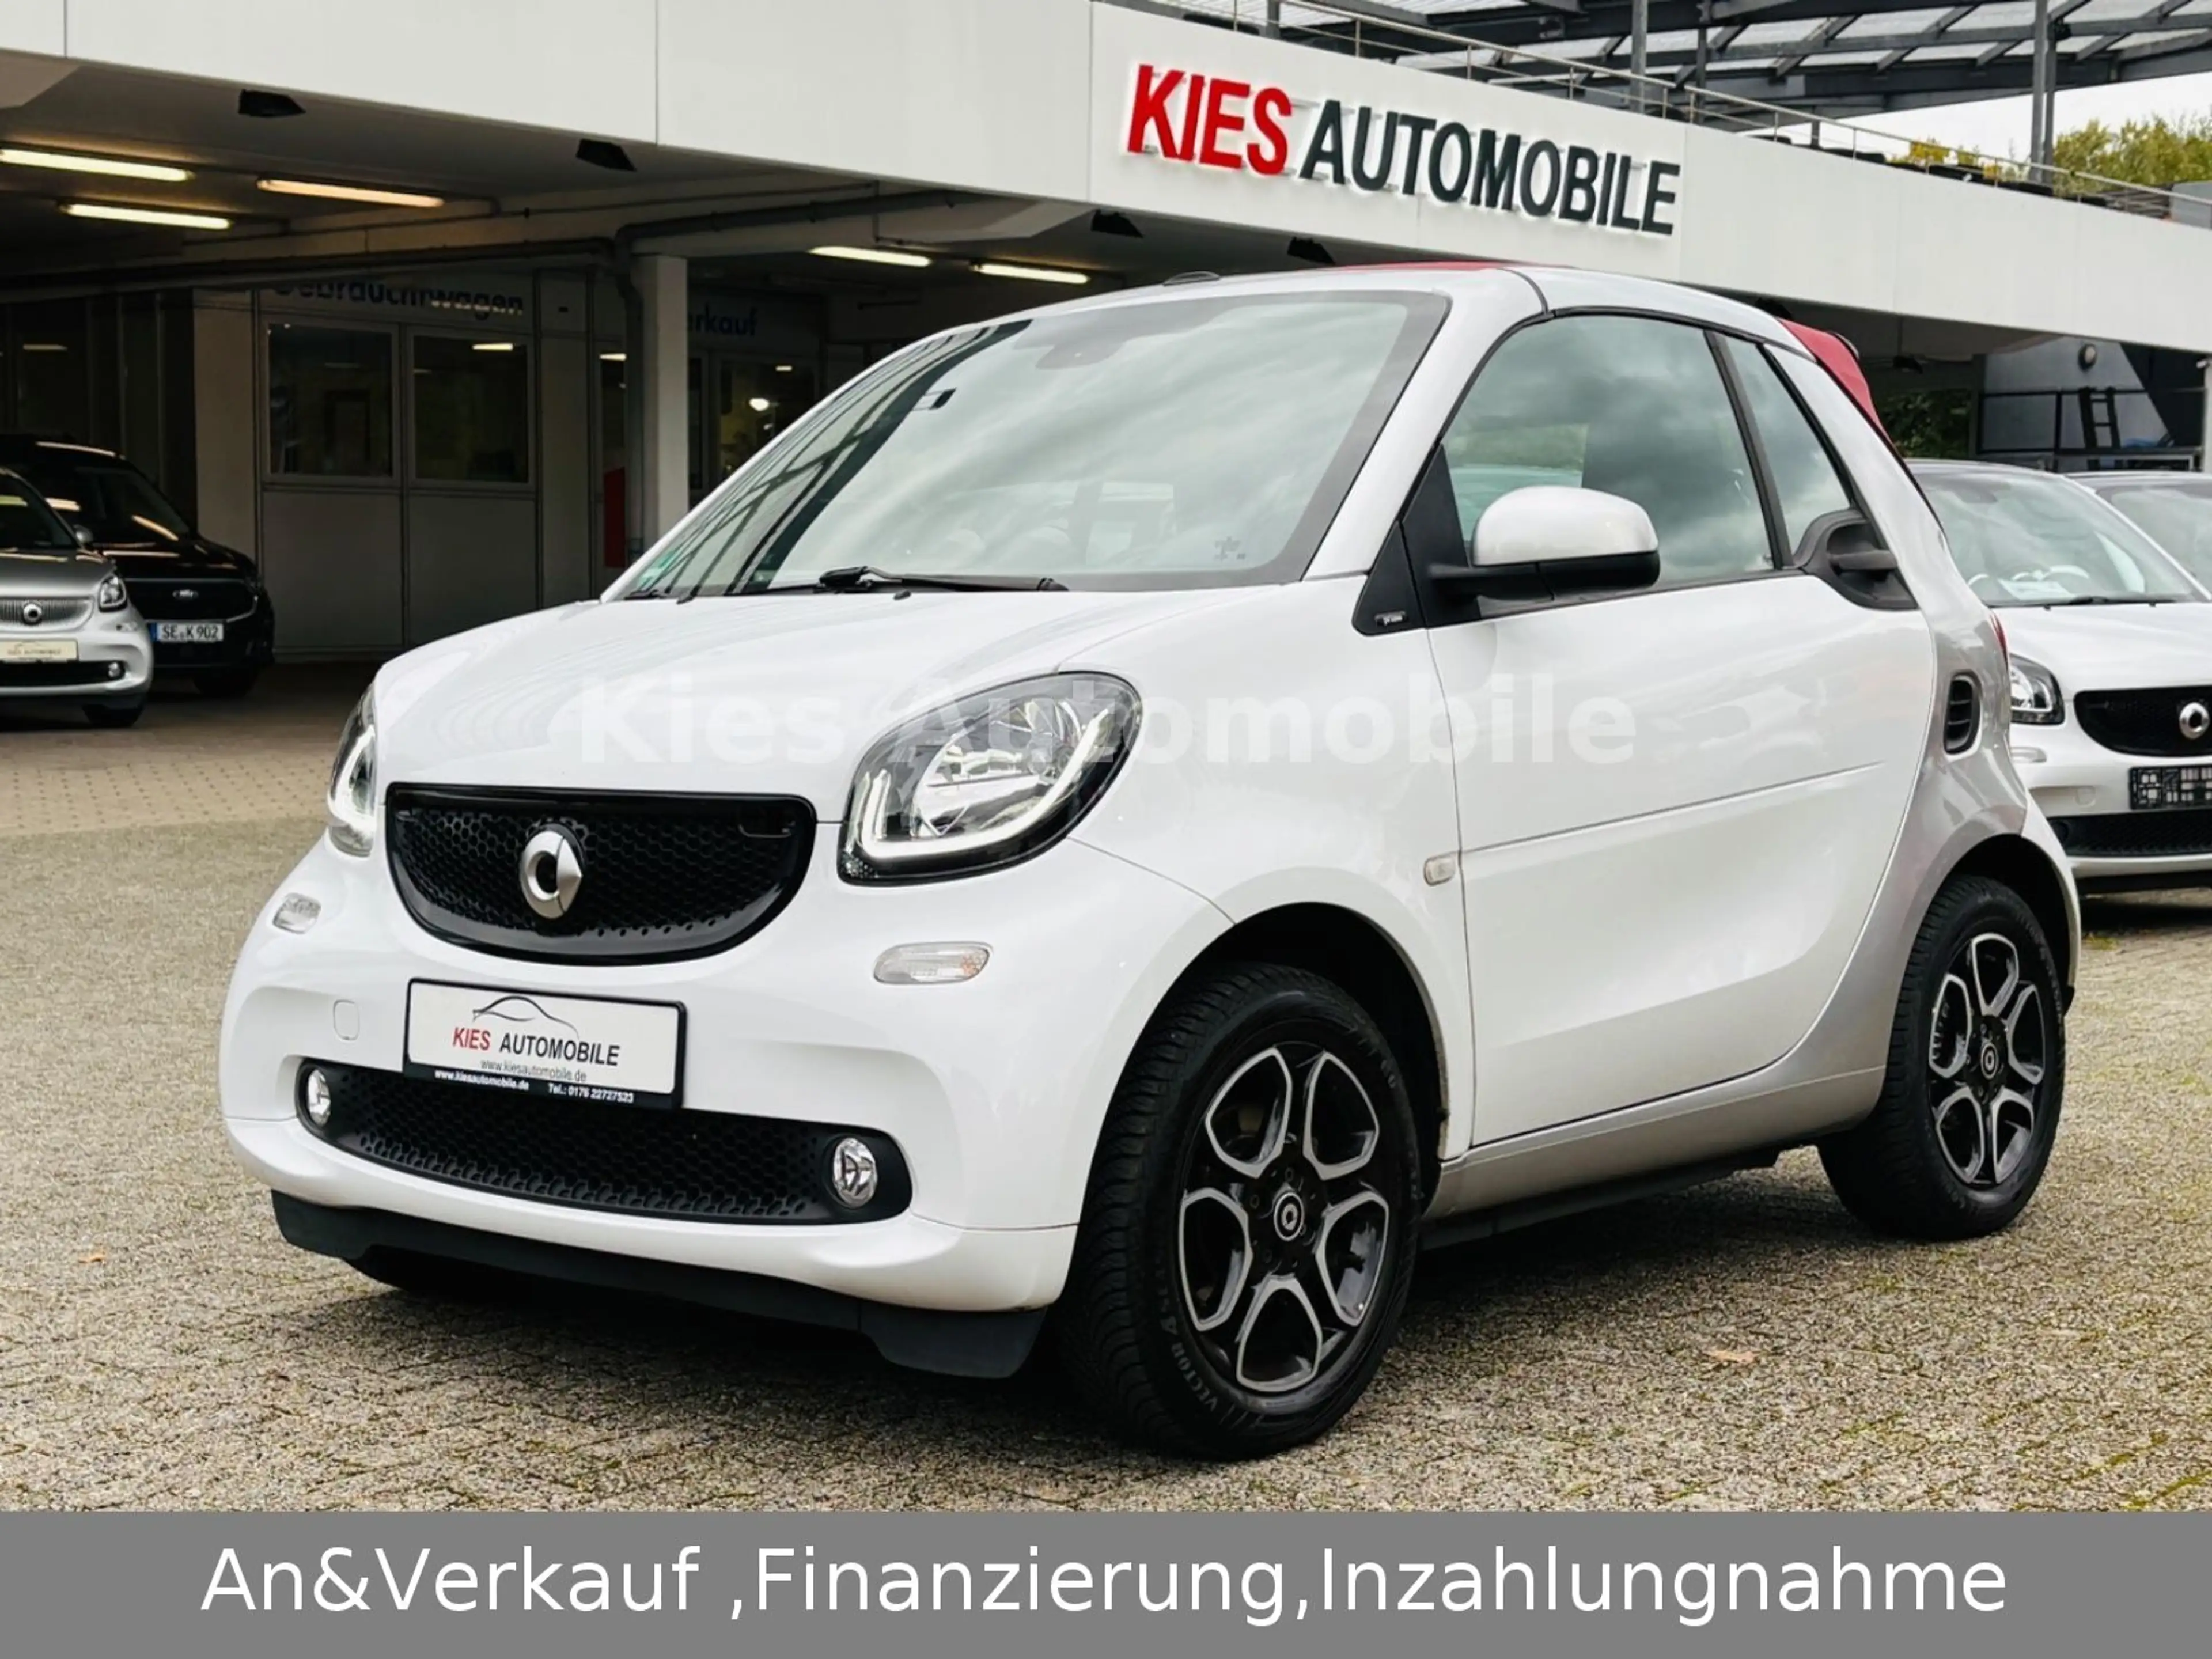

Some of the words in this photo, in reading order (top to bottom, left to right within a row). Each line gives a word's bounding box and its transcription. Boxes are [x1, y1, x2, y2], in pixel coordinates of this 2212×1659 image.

[1128, 65, 1293, 176] KIES
[1300, 99, 1680, 235] AUTOMOBILE
[452, 1027, 491, 1050] KIES
[499, 1033, 620, 1066] AUTOMOBILE
